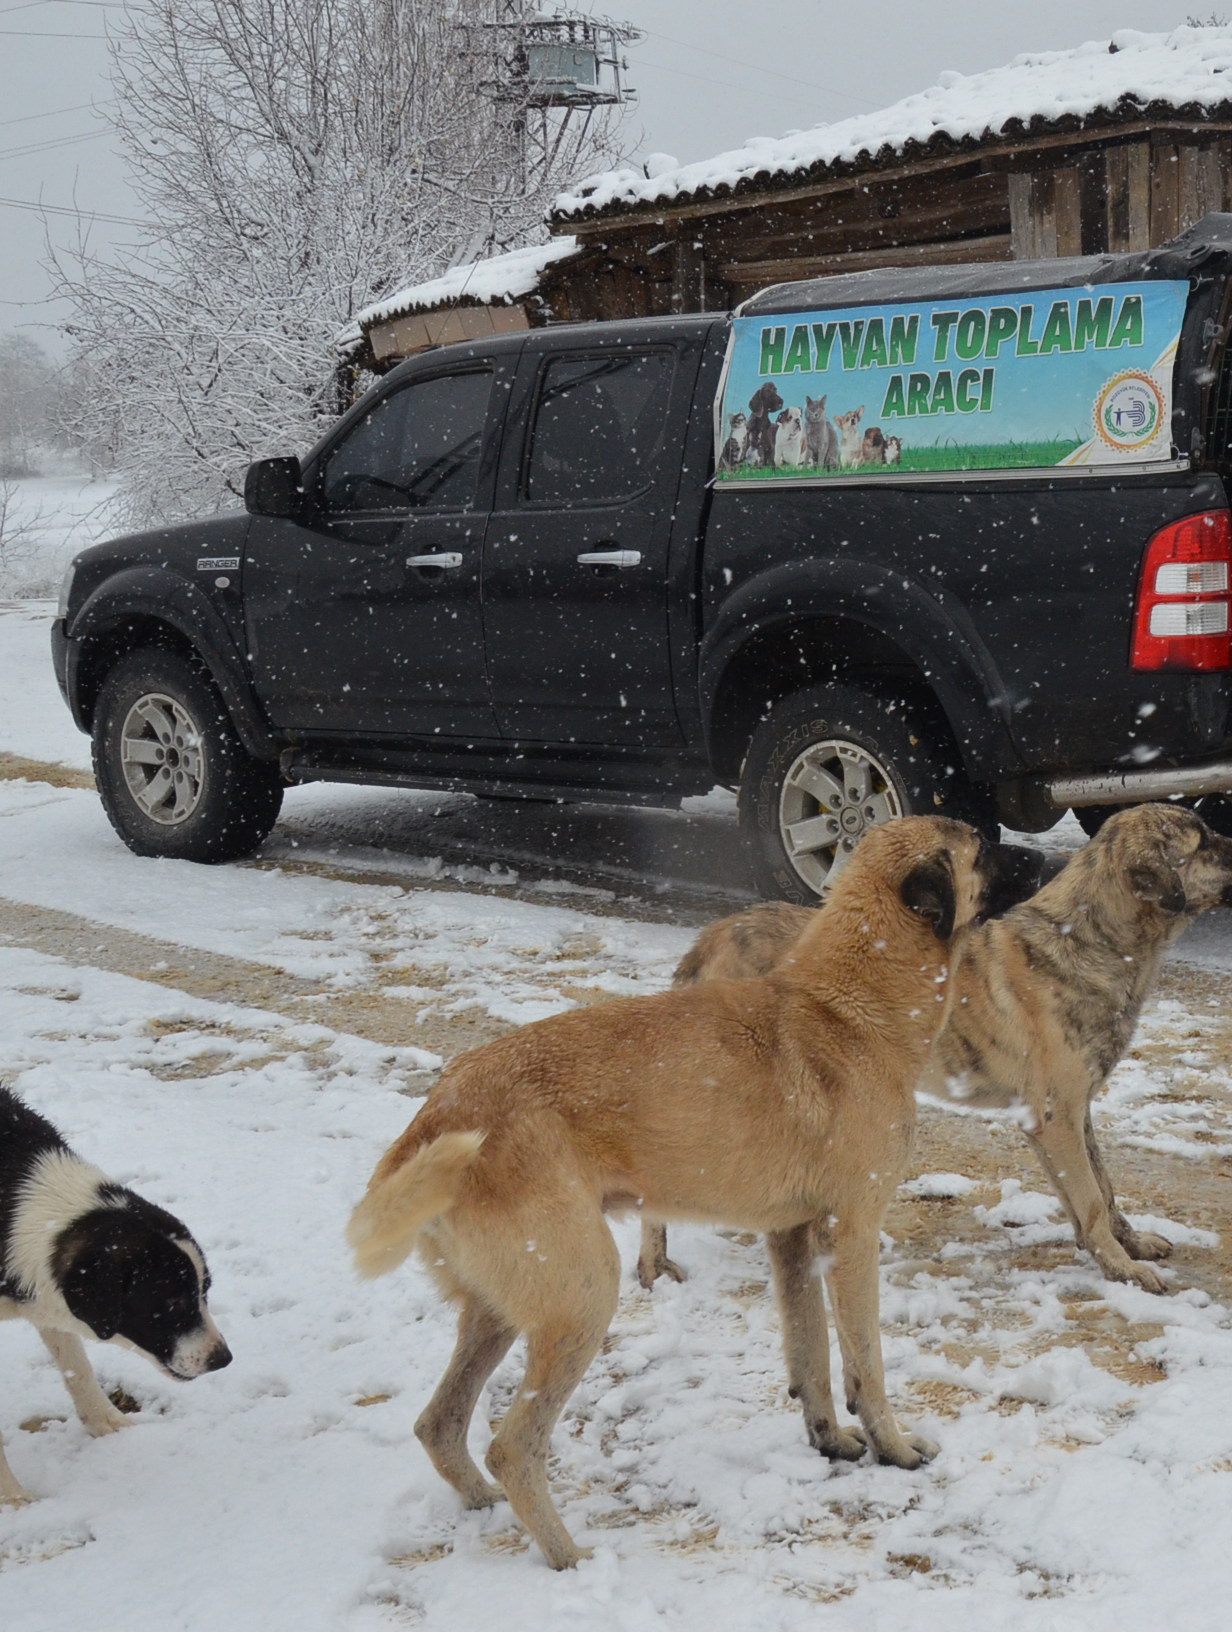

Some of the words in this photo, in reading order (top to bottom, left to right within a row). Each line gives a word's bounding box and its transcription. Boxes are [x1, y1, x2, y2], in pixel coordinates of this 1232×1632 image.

[758, 314, 920, 376] HAYVAN
[931, 295, 1144, 363] TOPLAMA
[880, 367, 995, 419] ARACI
[198, 559, 238, 569] RANGER
